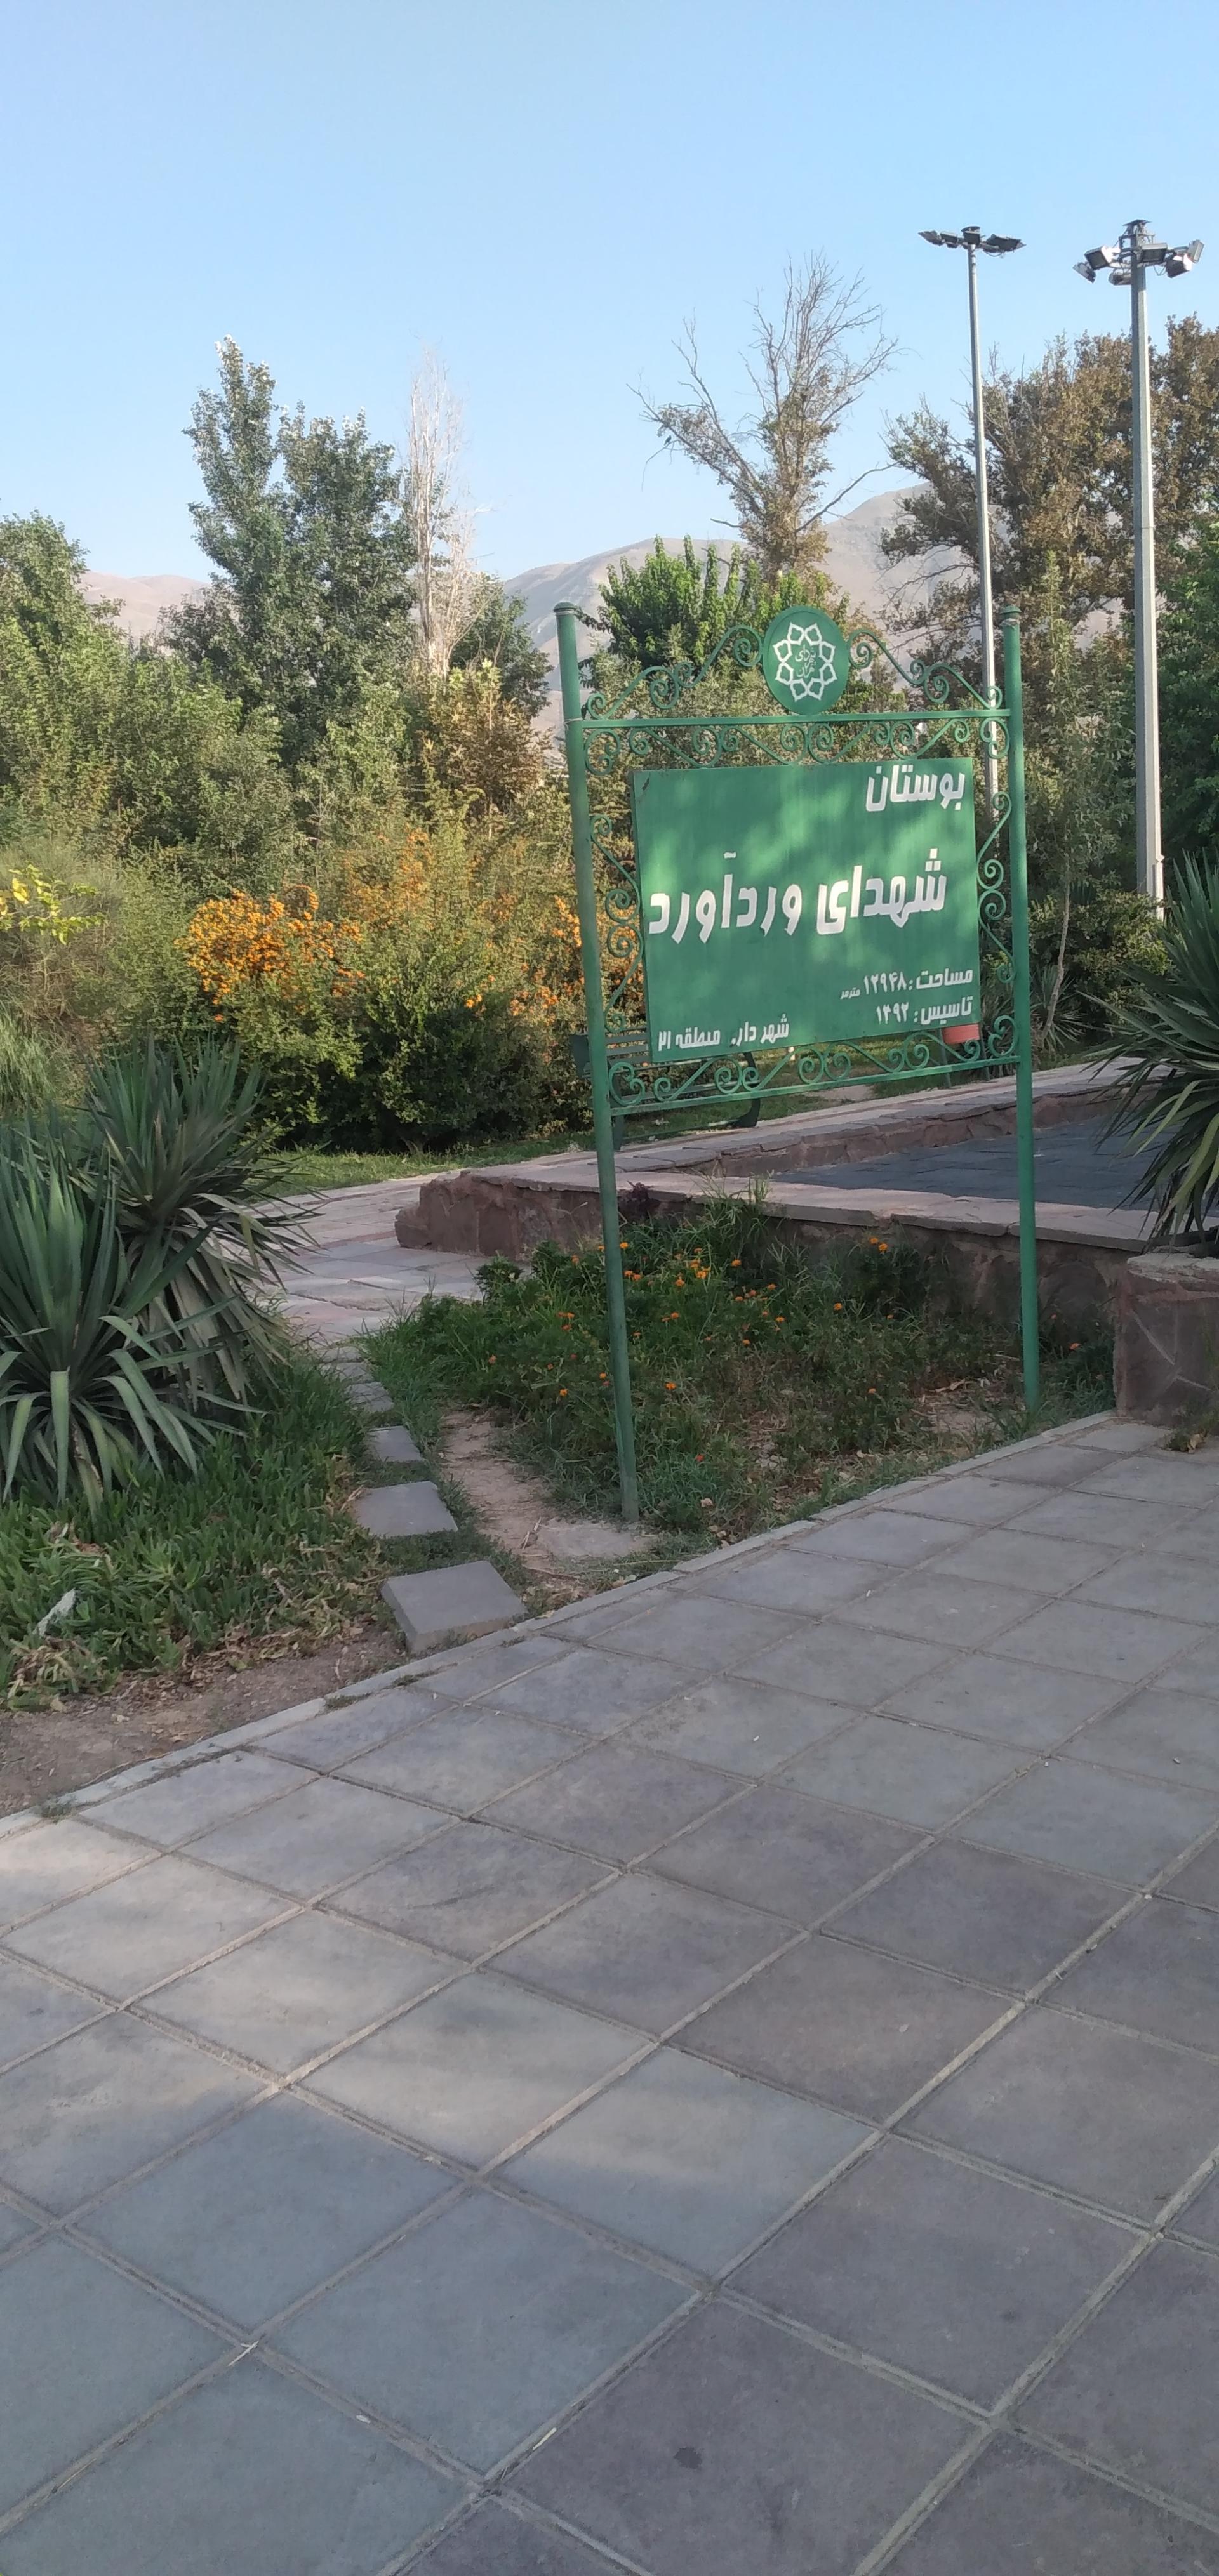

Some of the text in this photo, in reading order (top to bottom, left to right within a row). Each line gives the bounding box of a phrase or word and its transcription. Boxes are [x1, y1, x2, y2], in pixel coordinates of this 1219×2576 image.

[866, 765, 965, 812] بوستان
[649, 848, 947, 944] شهدای وردآورد
